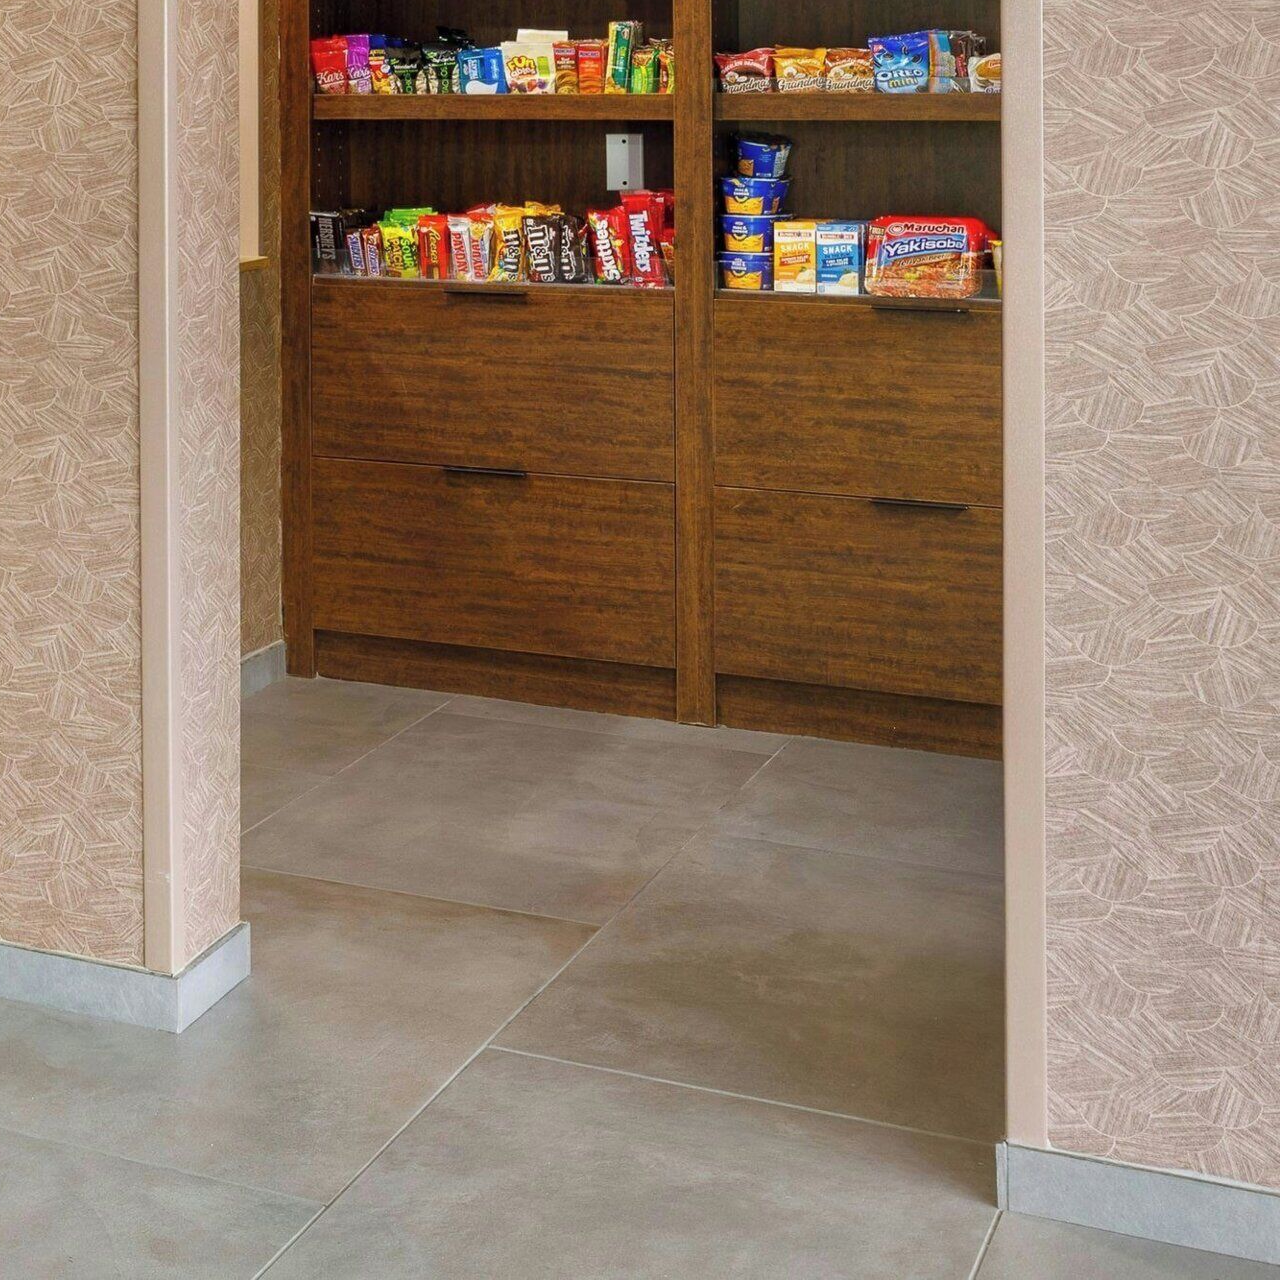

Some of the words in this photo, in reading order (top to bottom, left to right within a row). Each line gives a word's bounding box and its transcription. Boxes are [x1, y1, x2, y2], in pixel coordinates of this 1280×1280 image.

[317, 70, 345, 85] Kar's
[876, 68, 924, 81] OREO
[904, 223, 965, 234] Maruchan
[318, 218, 336, 260] HERSHEY'S
[780, 242, 810, 252] SNACK
[390, 238, 403, 270] PATCH
[401, 238, 414, 268] SOUR
[452, 233, 468, 273] PAYDAY
[823, 244, 853, 255] SNACK
[884, 239, 965, 257] Yakisoba
